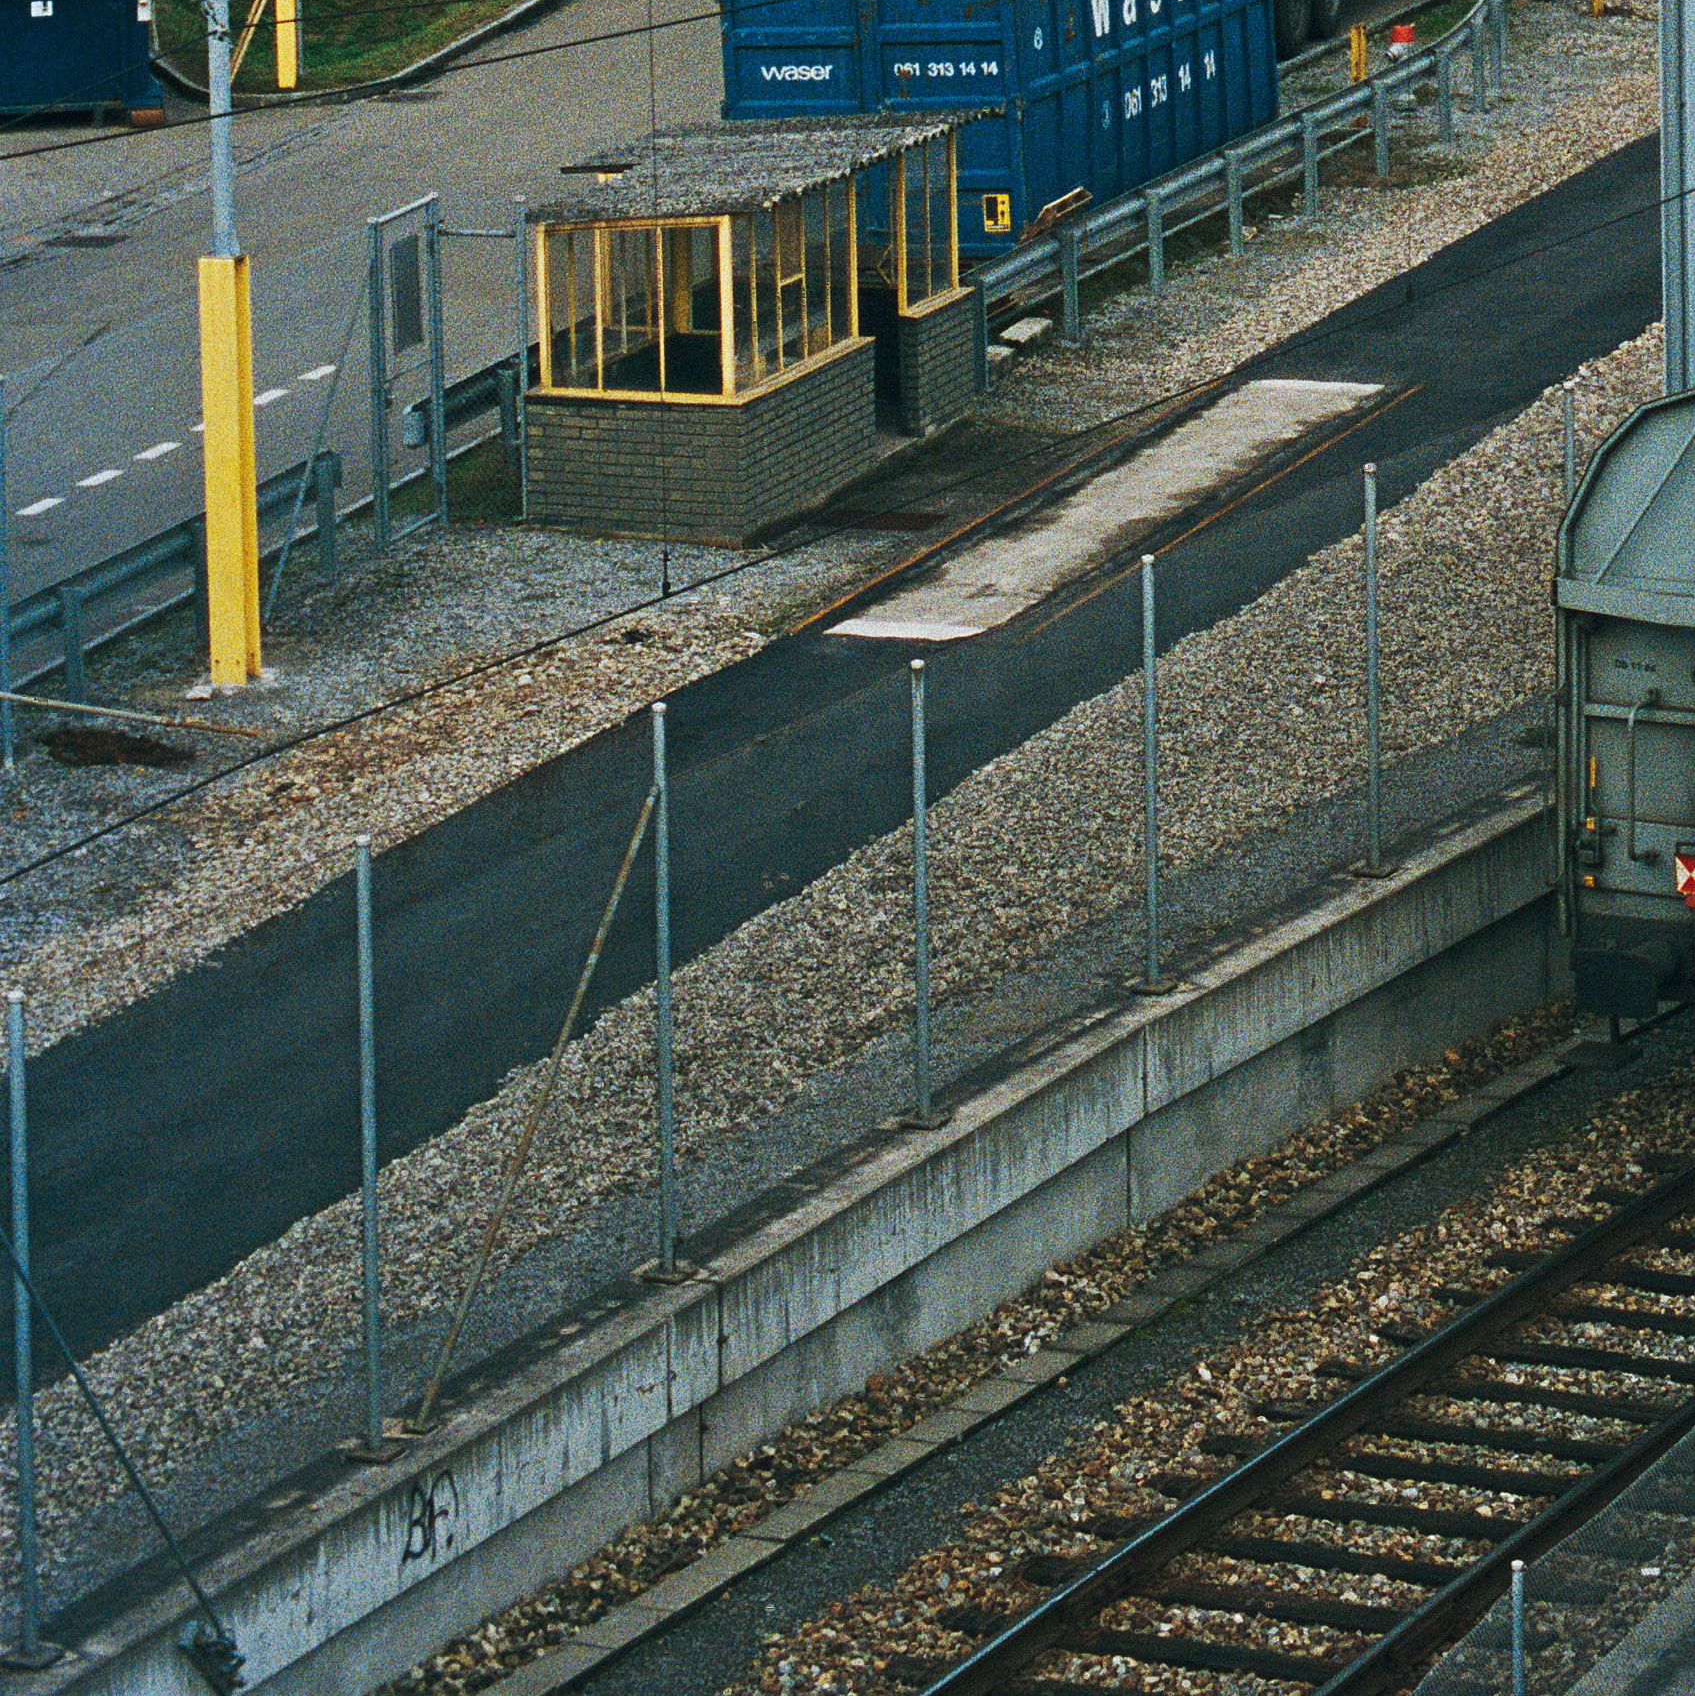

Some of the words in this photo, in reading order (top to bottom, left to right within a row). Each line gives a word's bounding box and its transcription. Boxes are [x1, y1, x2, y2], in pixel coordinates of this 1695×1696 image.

[760, 63, 834, 82] waser
[926, 61, 955, 78] 313
[958, 62, 977, 77] 14
[980, 60, 999, 77] 14
